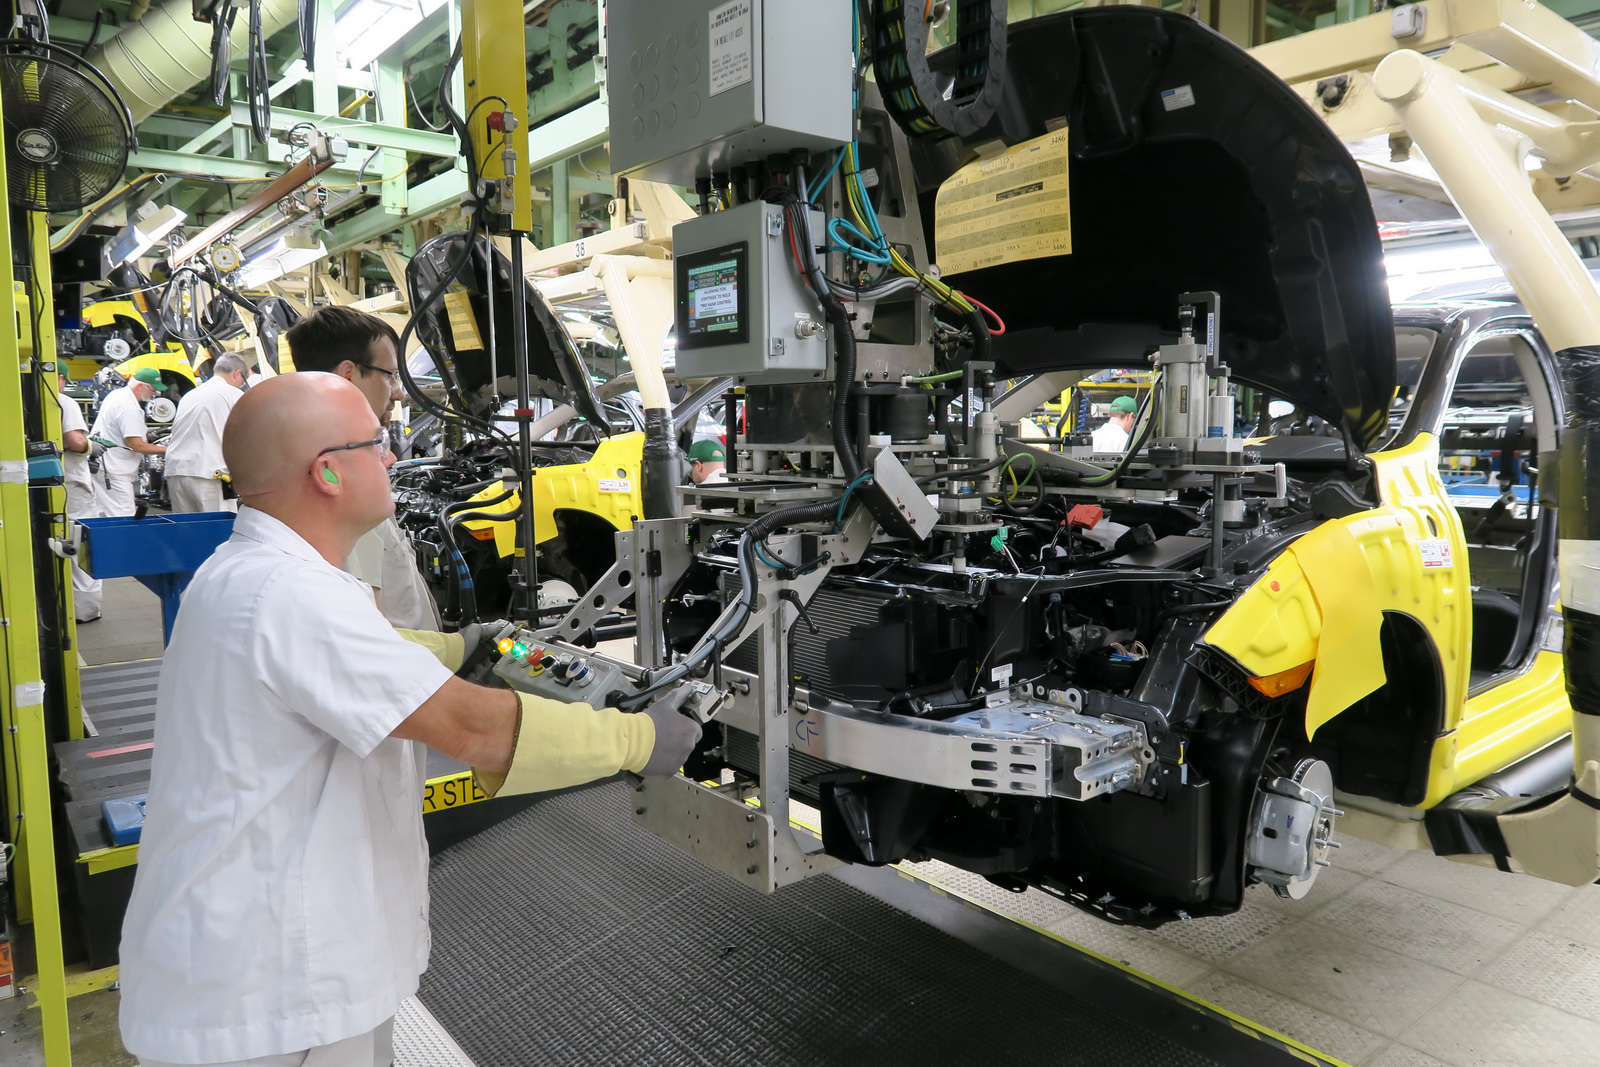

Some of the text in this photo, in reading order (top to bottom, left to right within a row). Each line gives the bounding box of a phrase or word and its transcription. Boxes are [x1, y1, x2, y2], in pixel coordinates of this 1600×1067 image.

[1050, 135, 1066, 146] 3486
[575, 241, 586, 258] 38
[1052, 243, 1067, 251] 3486
[1439, 544, 1451, 557] LH
[795, 719, 819, 748] CF
